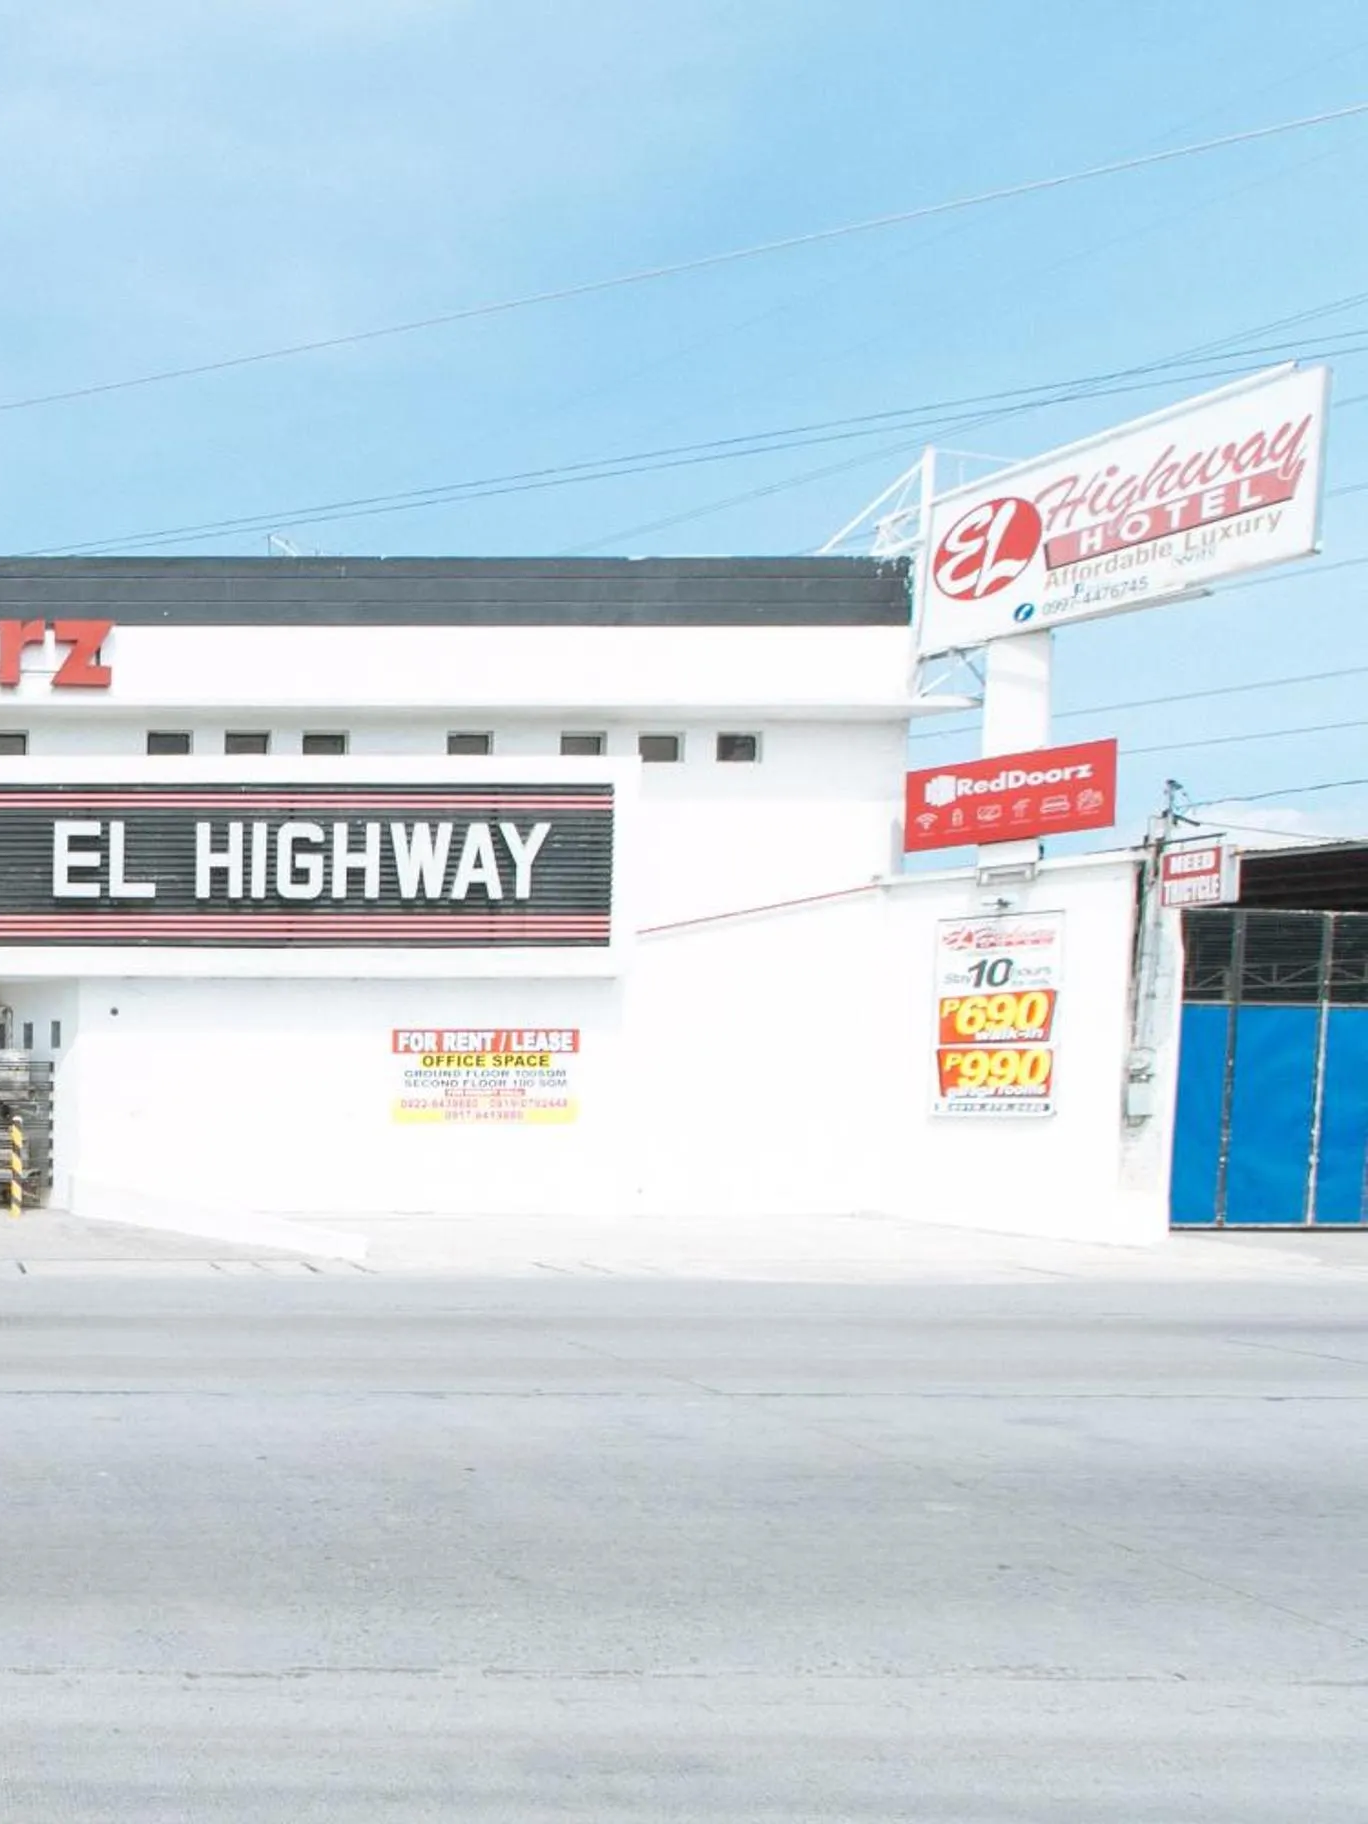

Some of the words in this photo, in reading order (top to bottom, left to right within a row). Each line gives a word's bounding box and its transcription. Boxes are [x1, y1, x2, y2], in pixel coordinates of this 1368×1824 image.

[1035, 413, 1312, 530] Highway
[1080, 481, 1263, 551] HOTEL
[1043, 540, 1173, 590] Affordable
[1183, 509, 1283, 554] Luxury
[956, 763, 1093, 797] RedDoorz
[53, 820, 155, 898] EL
[195, 821, 551, 899] HIGHWAY
[968, 957, 1013, 988] 10
[398, 1032, 438, 1051] FOR
[445, 1032, 492, 1051] RENT
[512, 1031, 573, 1051] LEASE
[422, 1055, 486, 1068] OFFICE
[492, 1054, 550, 1067] SPACE
